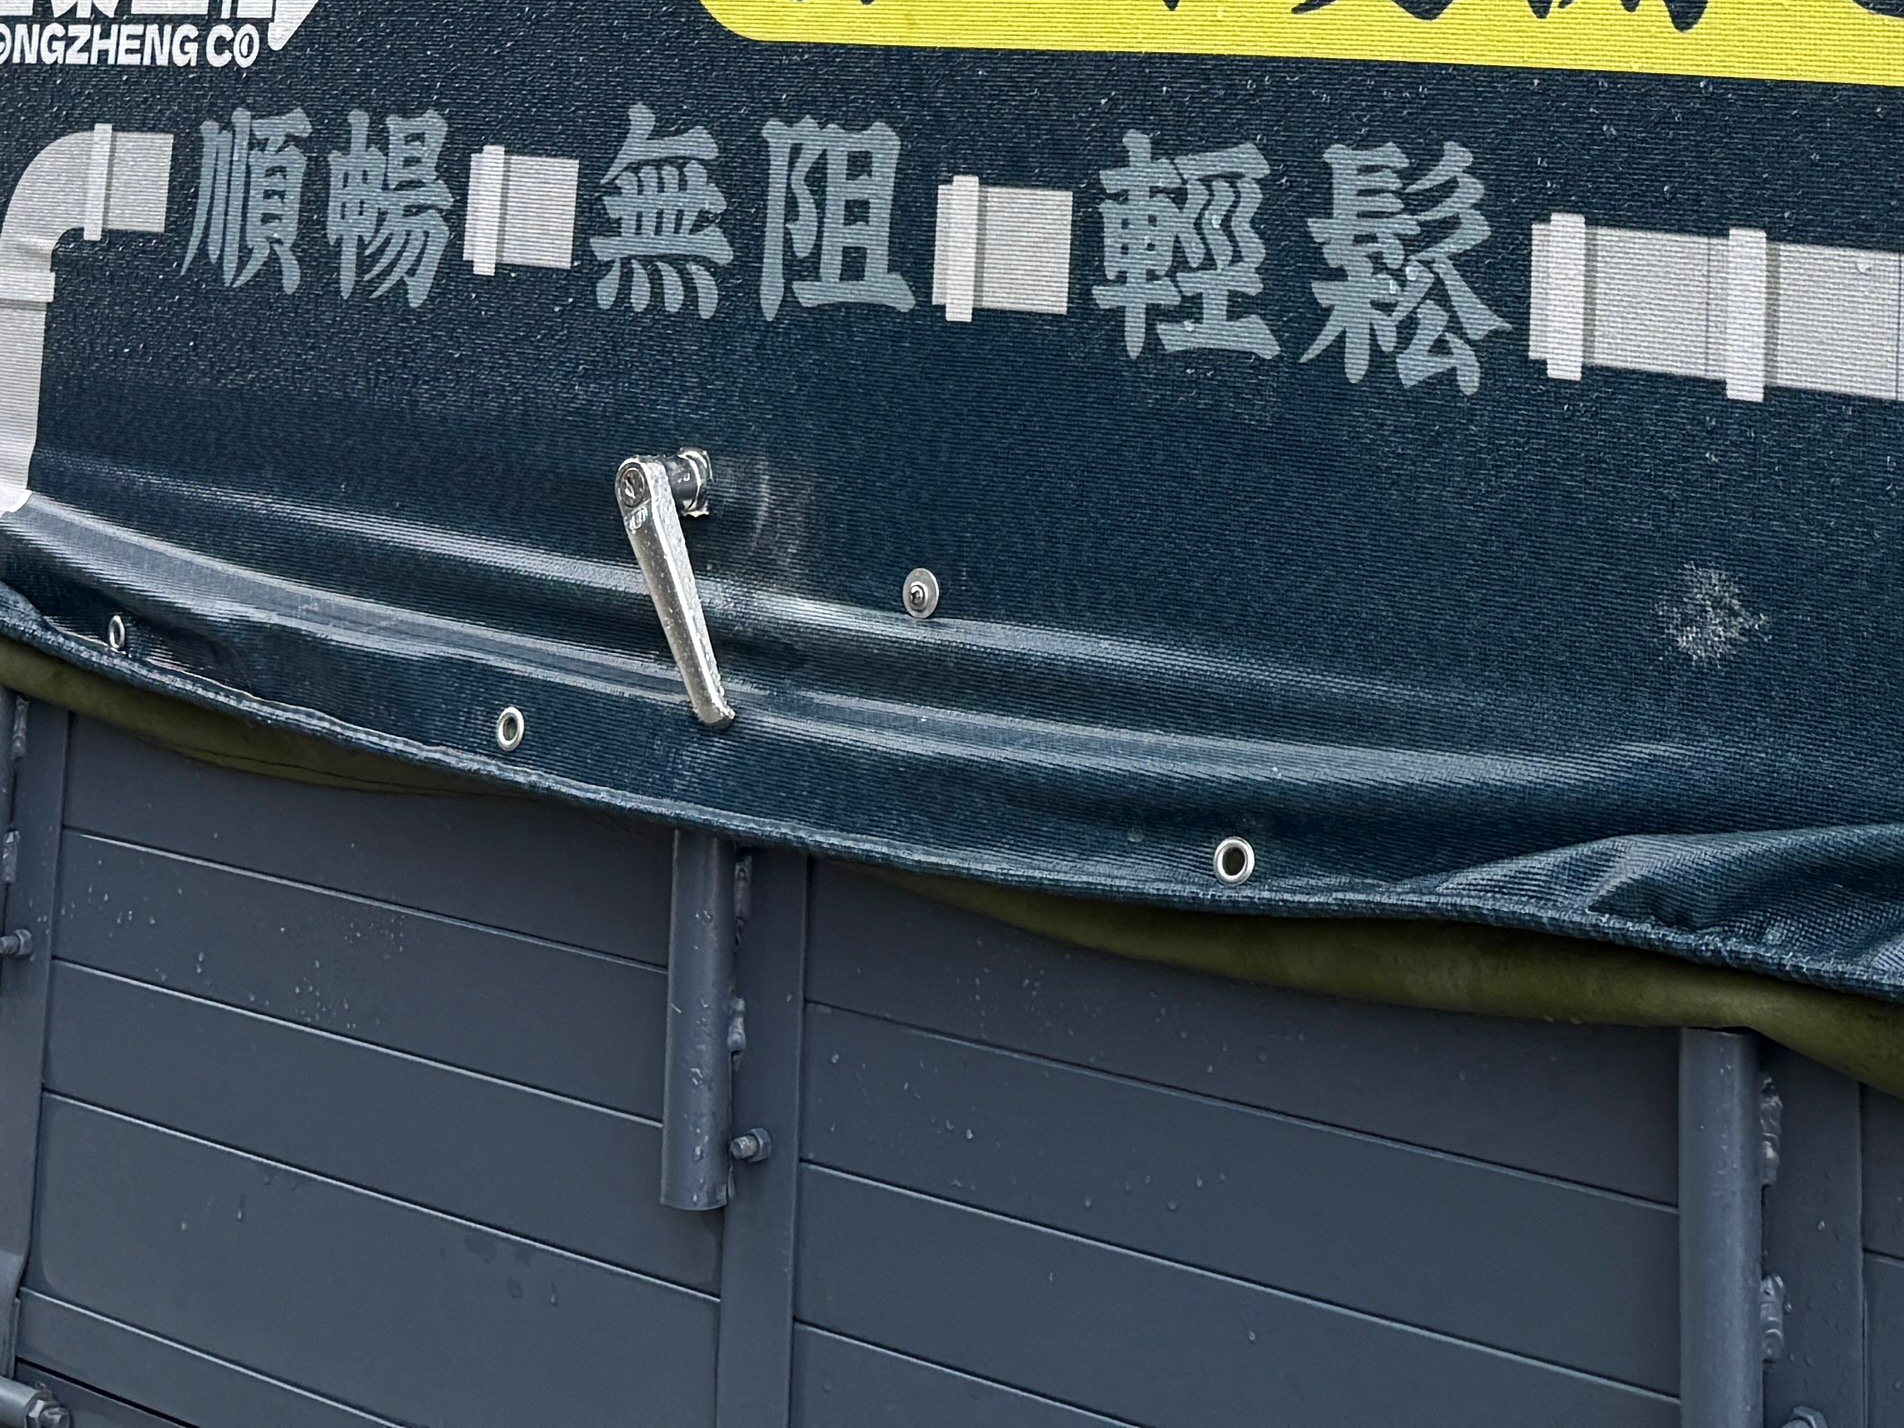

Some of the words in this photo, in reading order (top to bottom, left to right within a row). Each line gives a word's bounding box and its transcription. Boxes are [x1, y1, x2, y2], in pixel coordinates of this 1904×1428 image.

[205, 22, 261, 69] CO
[179, 100, 456, 312] 順暢
[594, 102, 917, 324] 無阻
[1091, 129, 1508, 398] 輕鬆
